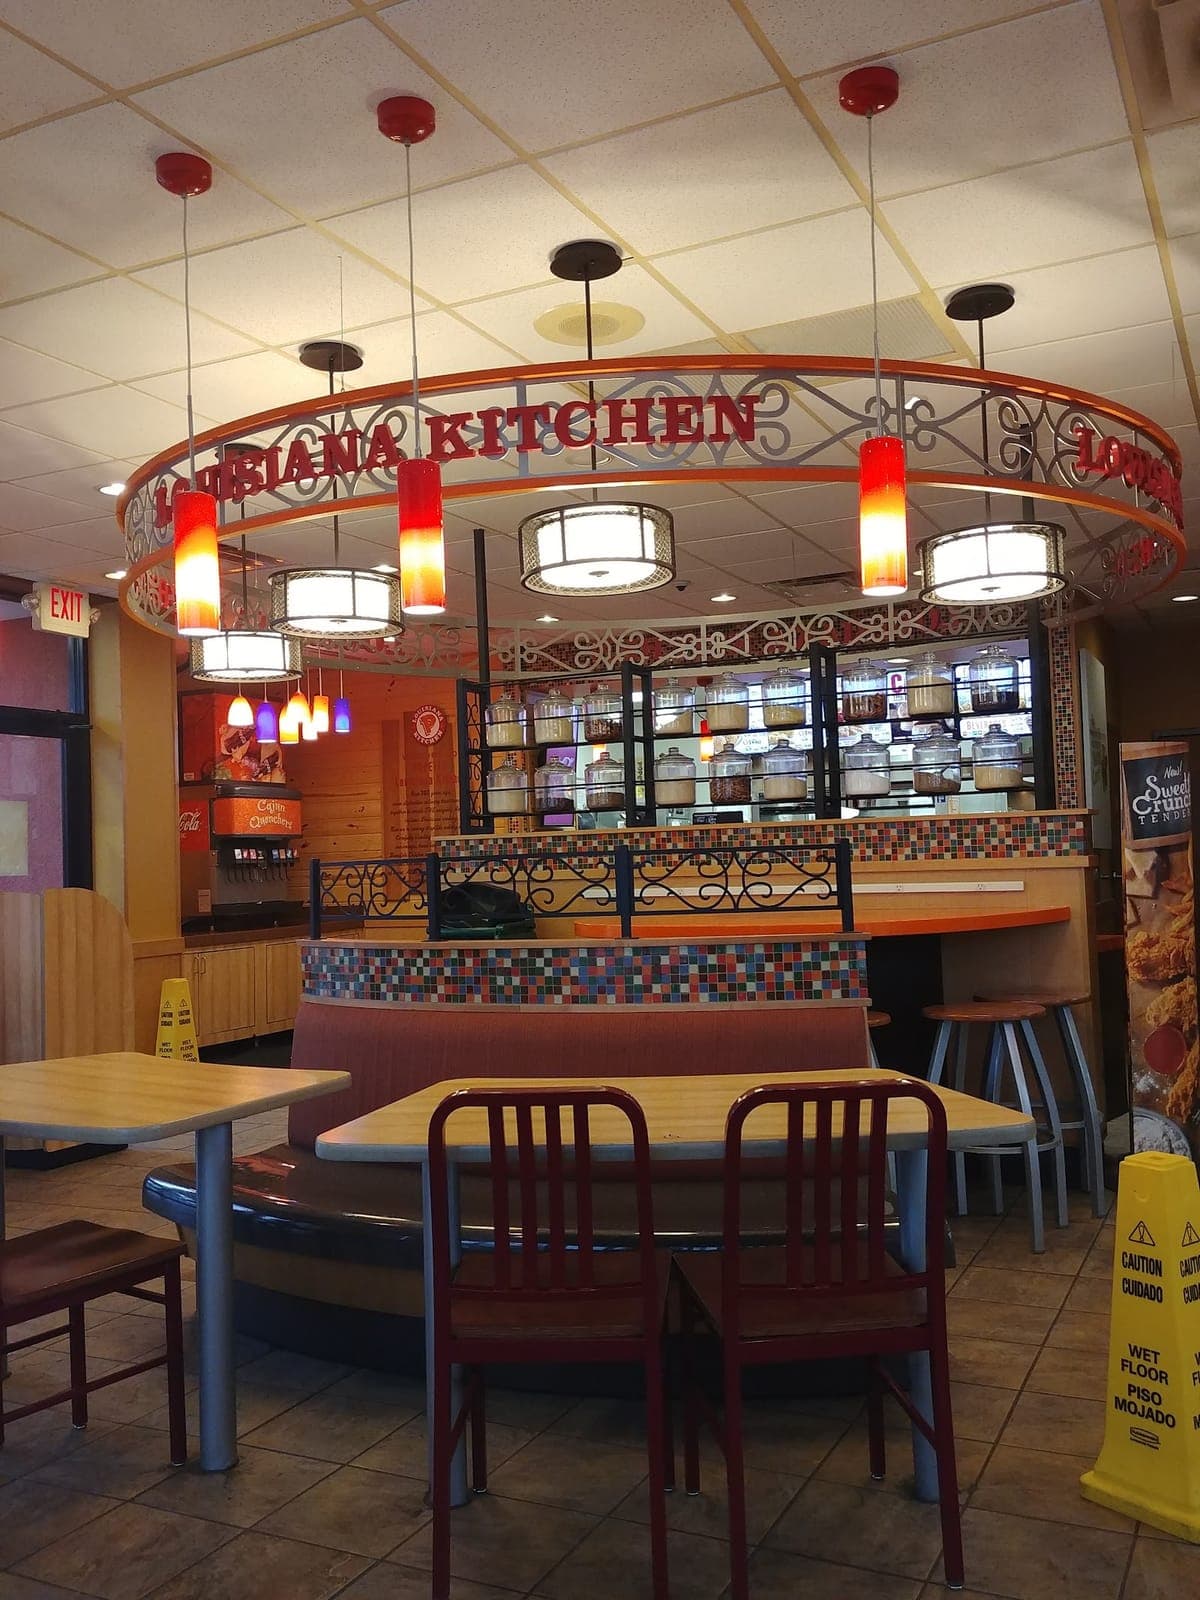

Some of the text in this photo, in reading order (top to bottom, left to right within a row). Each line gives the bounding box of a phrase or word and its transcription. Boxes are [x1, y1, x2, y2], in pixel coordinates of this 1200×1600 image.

[425, 394, 762, 462] KITCHEN
[51, 588, 83, 622] EXIT
[412, 706, 444, 723] LOUISIANA
[413, 730, 443, 744] KITCHEN
[257, 799, 286, 814] Cajun
[1121, 1251, 1163, 1278] CAUTION
[1121, 1277, 1163, 1304] CUIDADO
[1128, 1343, 1160, 1365] WET
[1120, 1358, 1169, 1385] FLOOR
[1127, 1383, 1162, 1406] PISO
[1114, 1396, 1176, 1429] MOJADO
